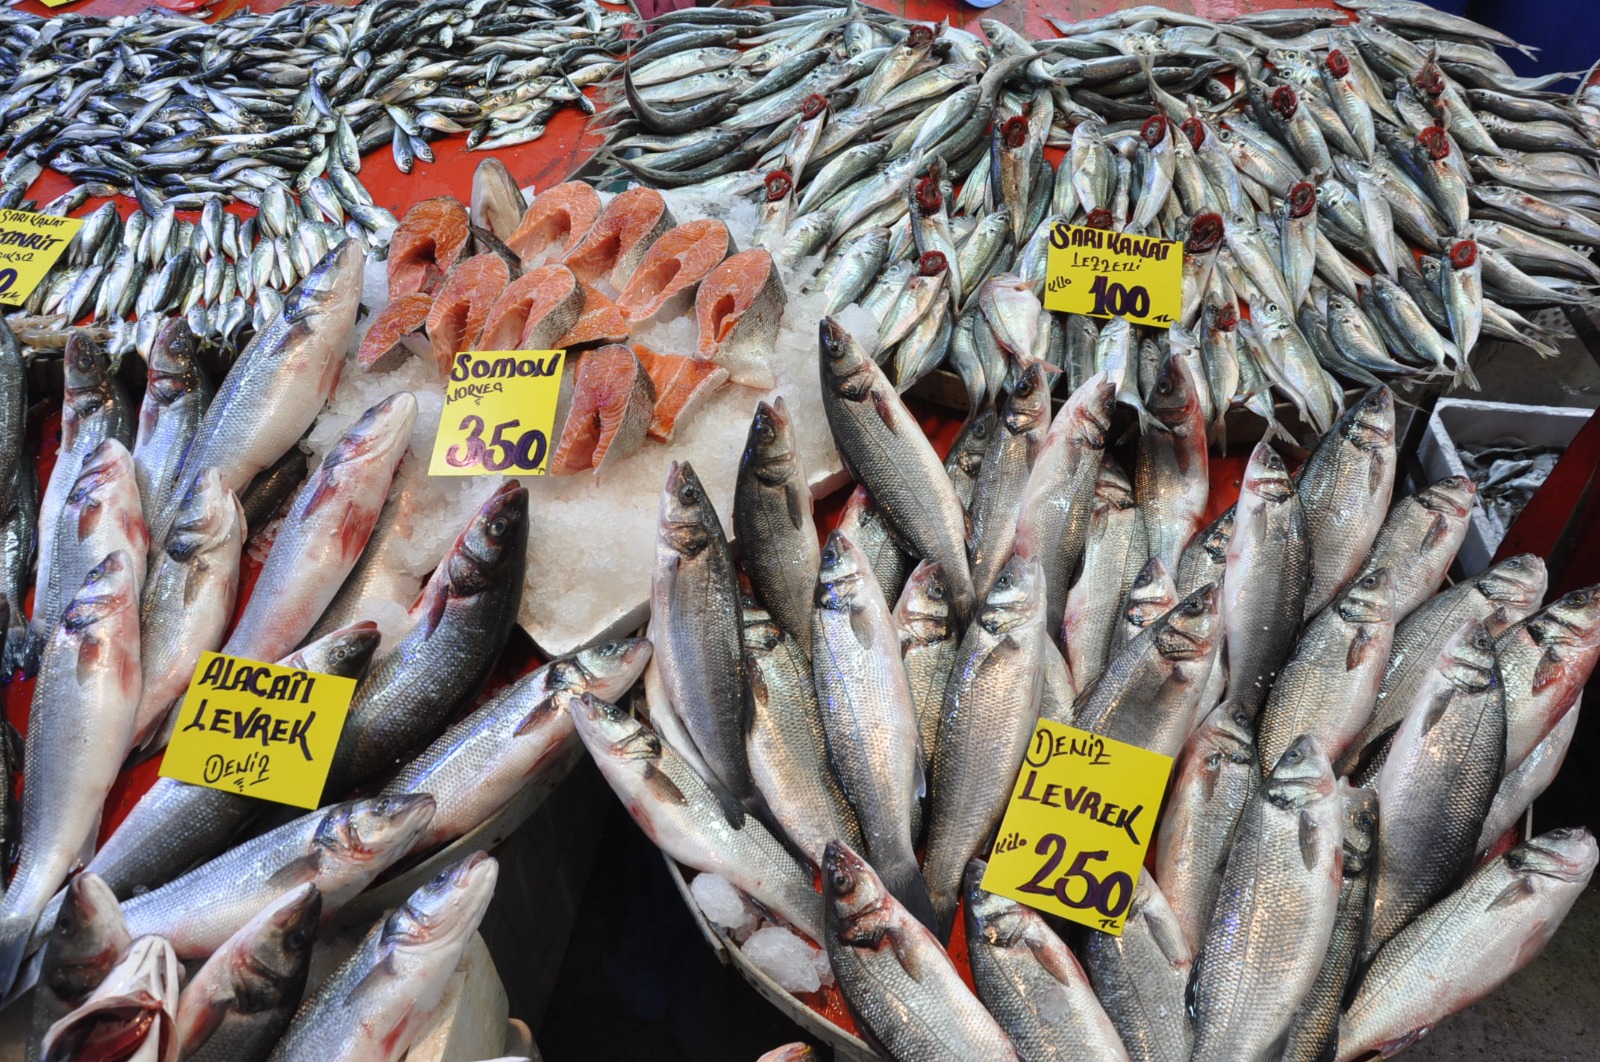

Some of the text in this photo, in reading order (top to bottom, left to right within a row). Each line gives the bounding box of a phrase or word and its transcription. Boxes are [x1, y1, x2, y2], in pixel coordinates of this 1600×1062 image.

[1086, 275, 1150, 318] 100
[446, 414, 547, 471] 350
[182, 699, 316, 761] LEVREK
[1018, 771, 1143, 845] LEVREK
[1015, 833, 1133, 917] 250
